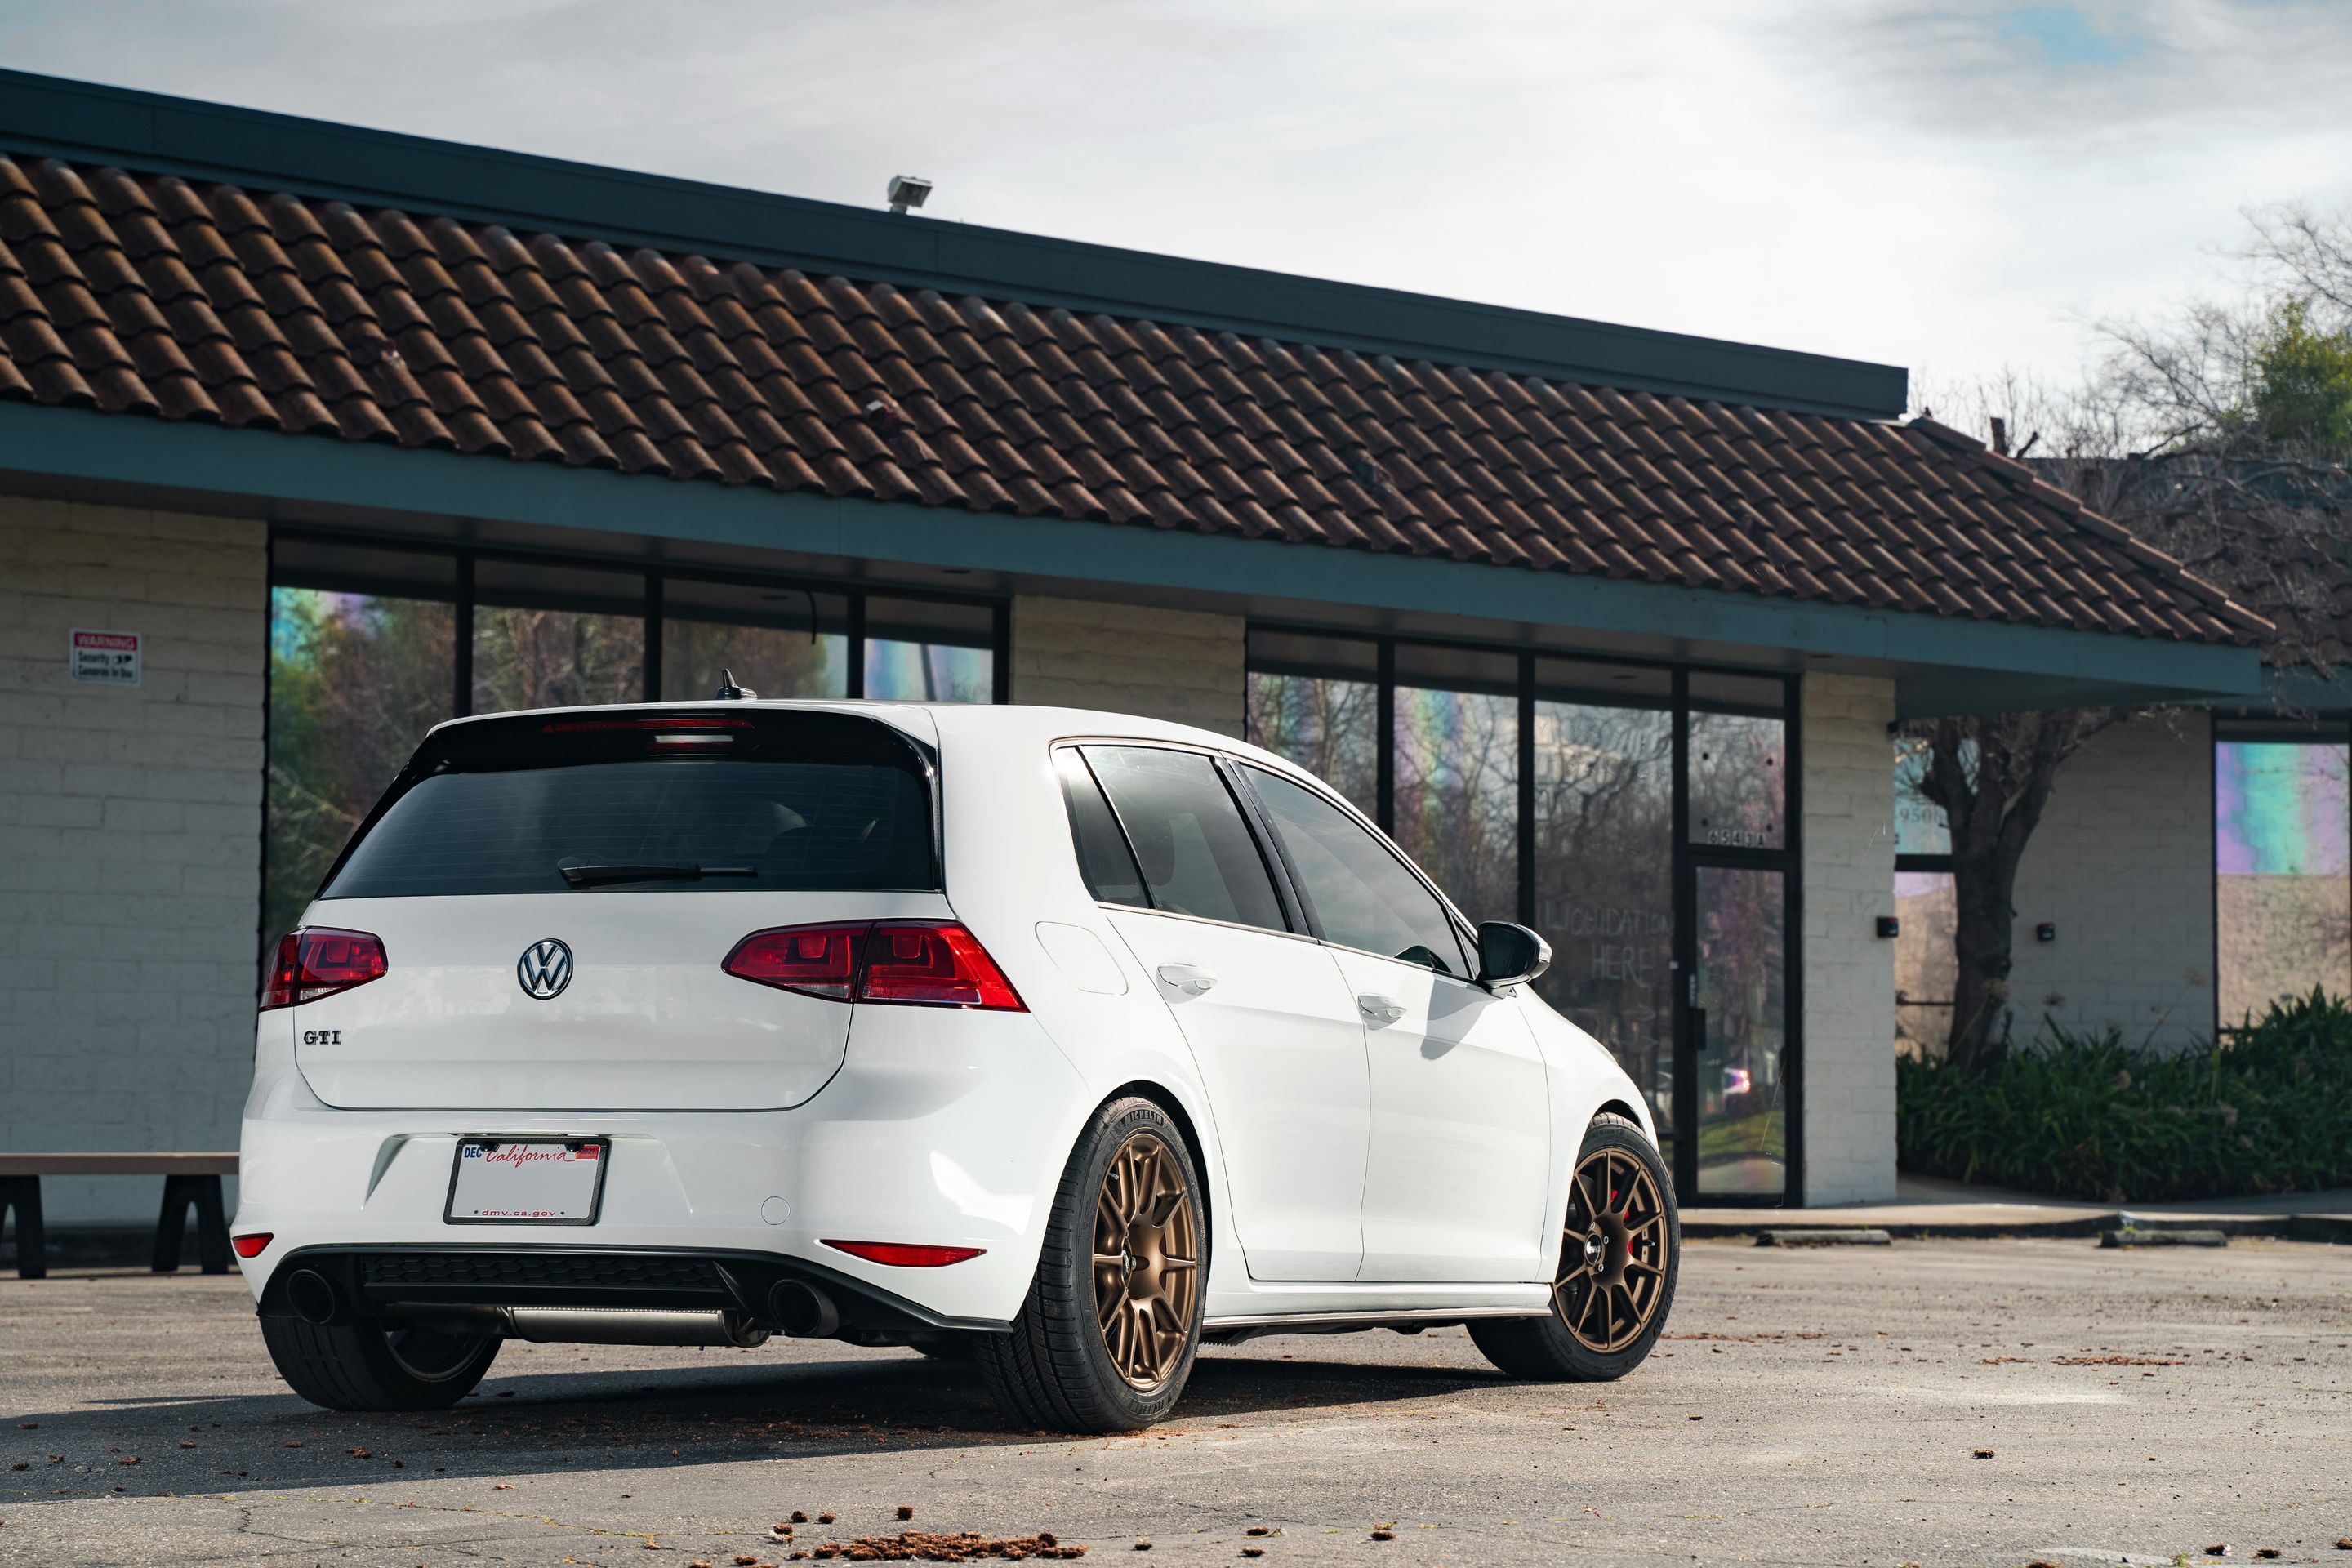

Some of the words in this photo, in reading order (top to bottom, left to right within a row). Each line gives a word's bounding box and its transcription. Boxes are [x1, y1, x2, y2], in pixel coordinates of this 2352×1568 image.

[303, 1030, 341, 1045] GTI
[1125, 1110, 1163, 1126] MICHELIN
[464, 1147, 482, 1159] DEC
[485, 1145, 576, 1168] California
[481, 1209, 556, 1218] dmv.ca.gov
